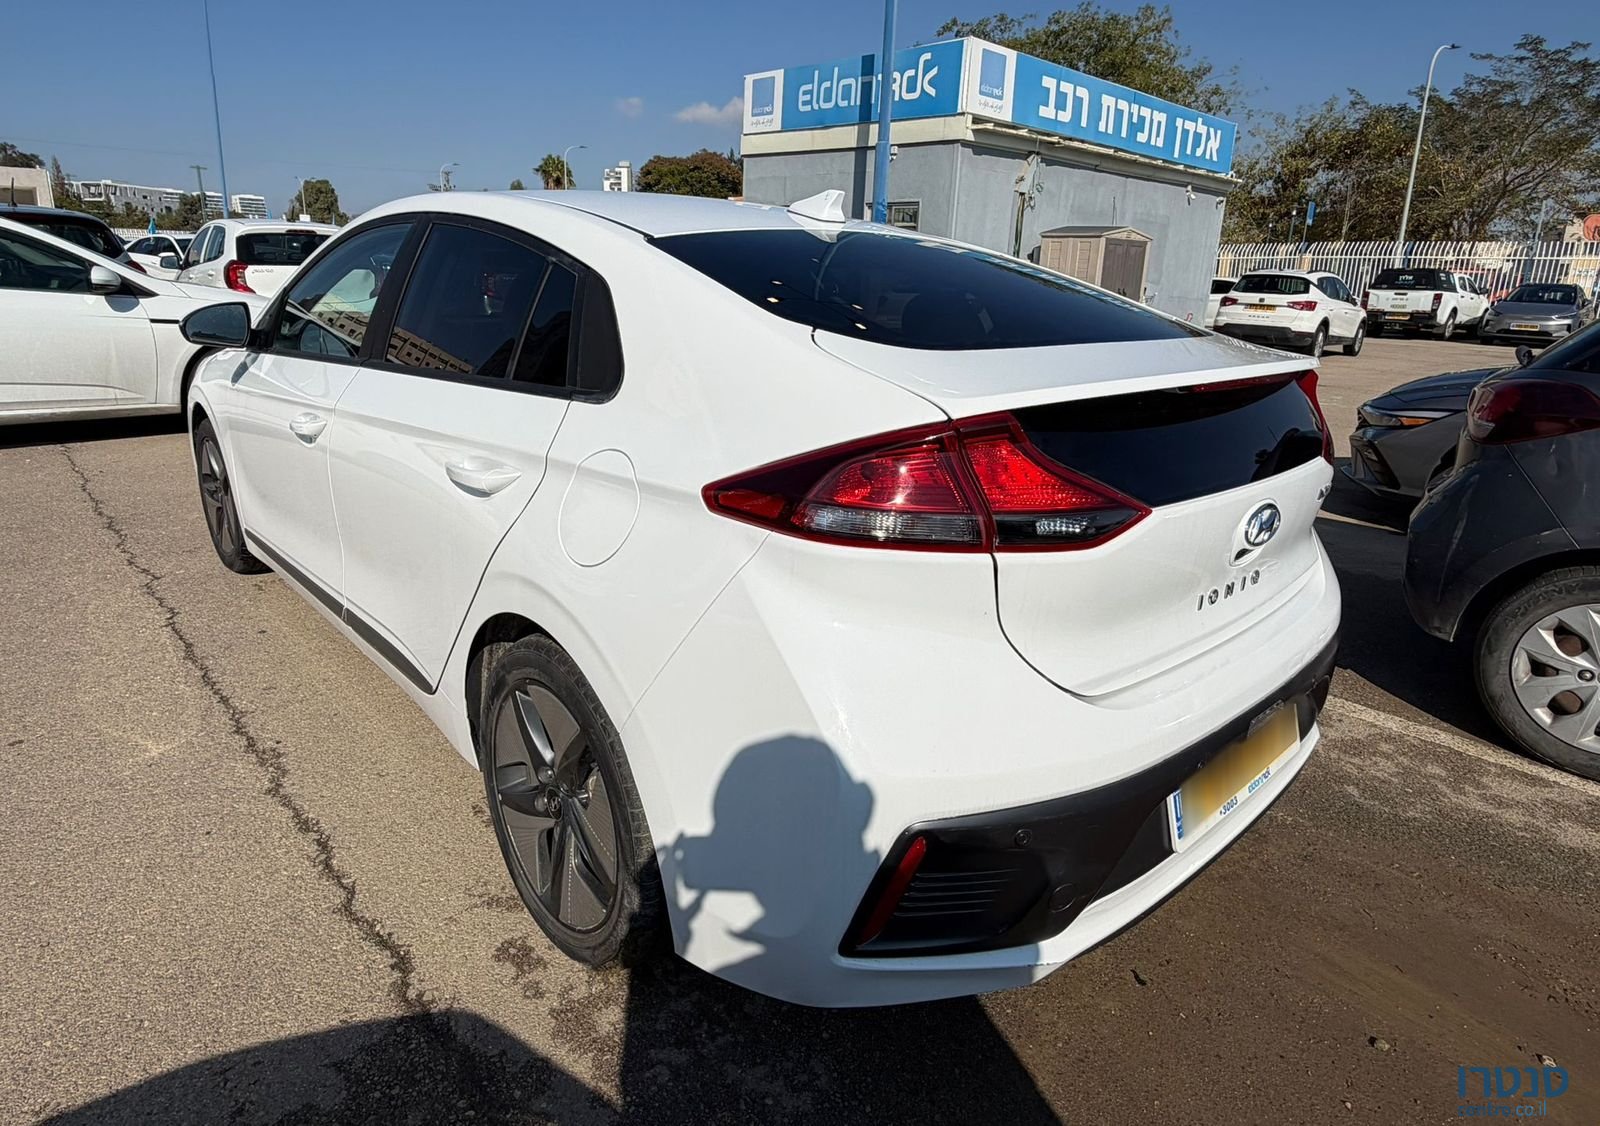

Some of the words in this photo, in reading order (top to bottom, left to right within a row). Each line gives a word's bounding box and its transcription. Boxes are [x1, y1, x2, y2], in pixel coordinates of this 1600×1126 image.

[1038, 74, 1090, 129] רכב
[1098, 93, 1168, 149] מכירת
[1173, 116, 1222, 162] אלדן
[1196, 569, 1261, 611] IONIQ
